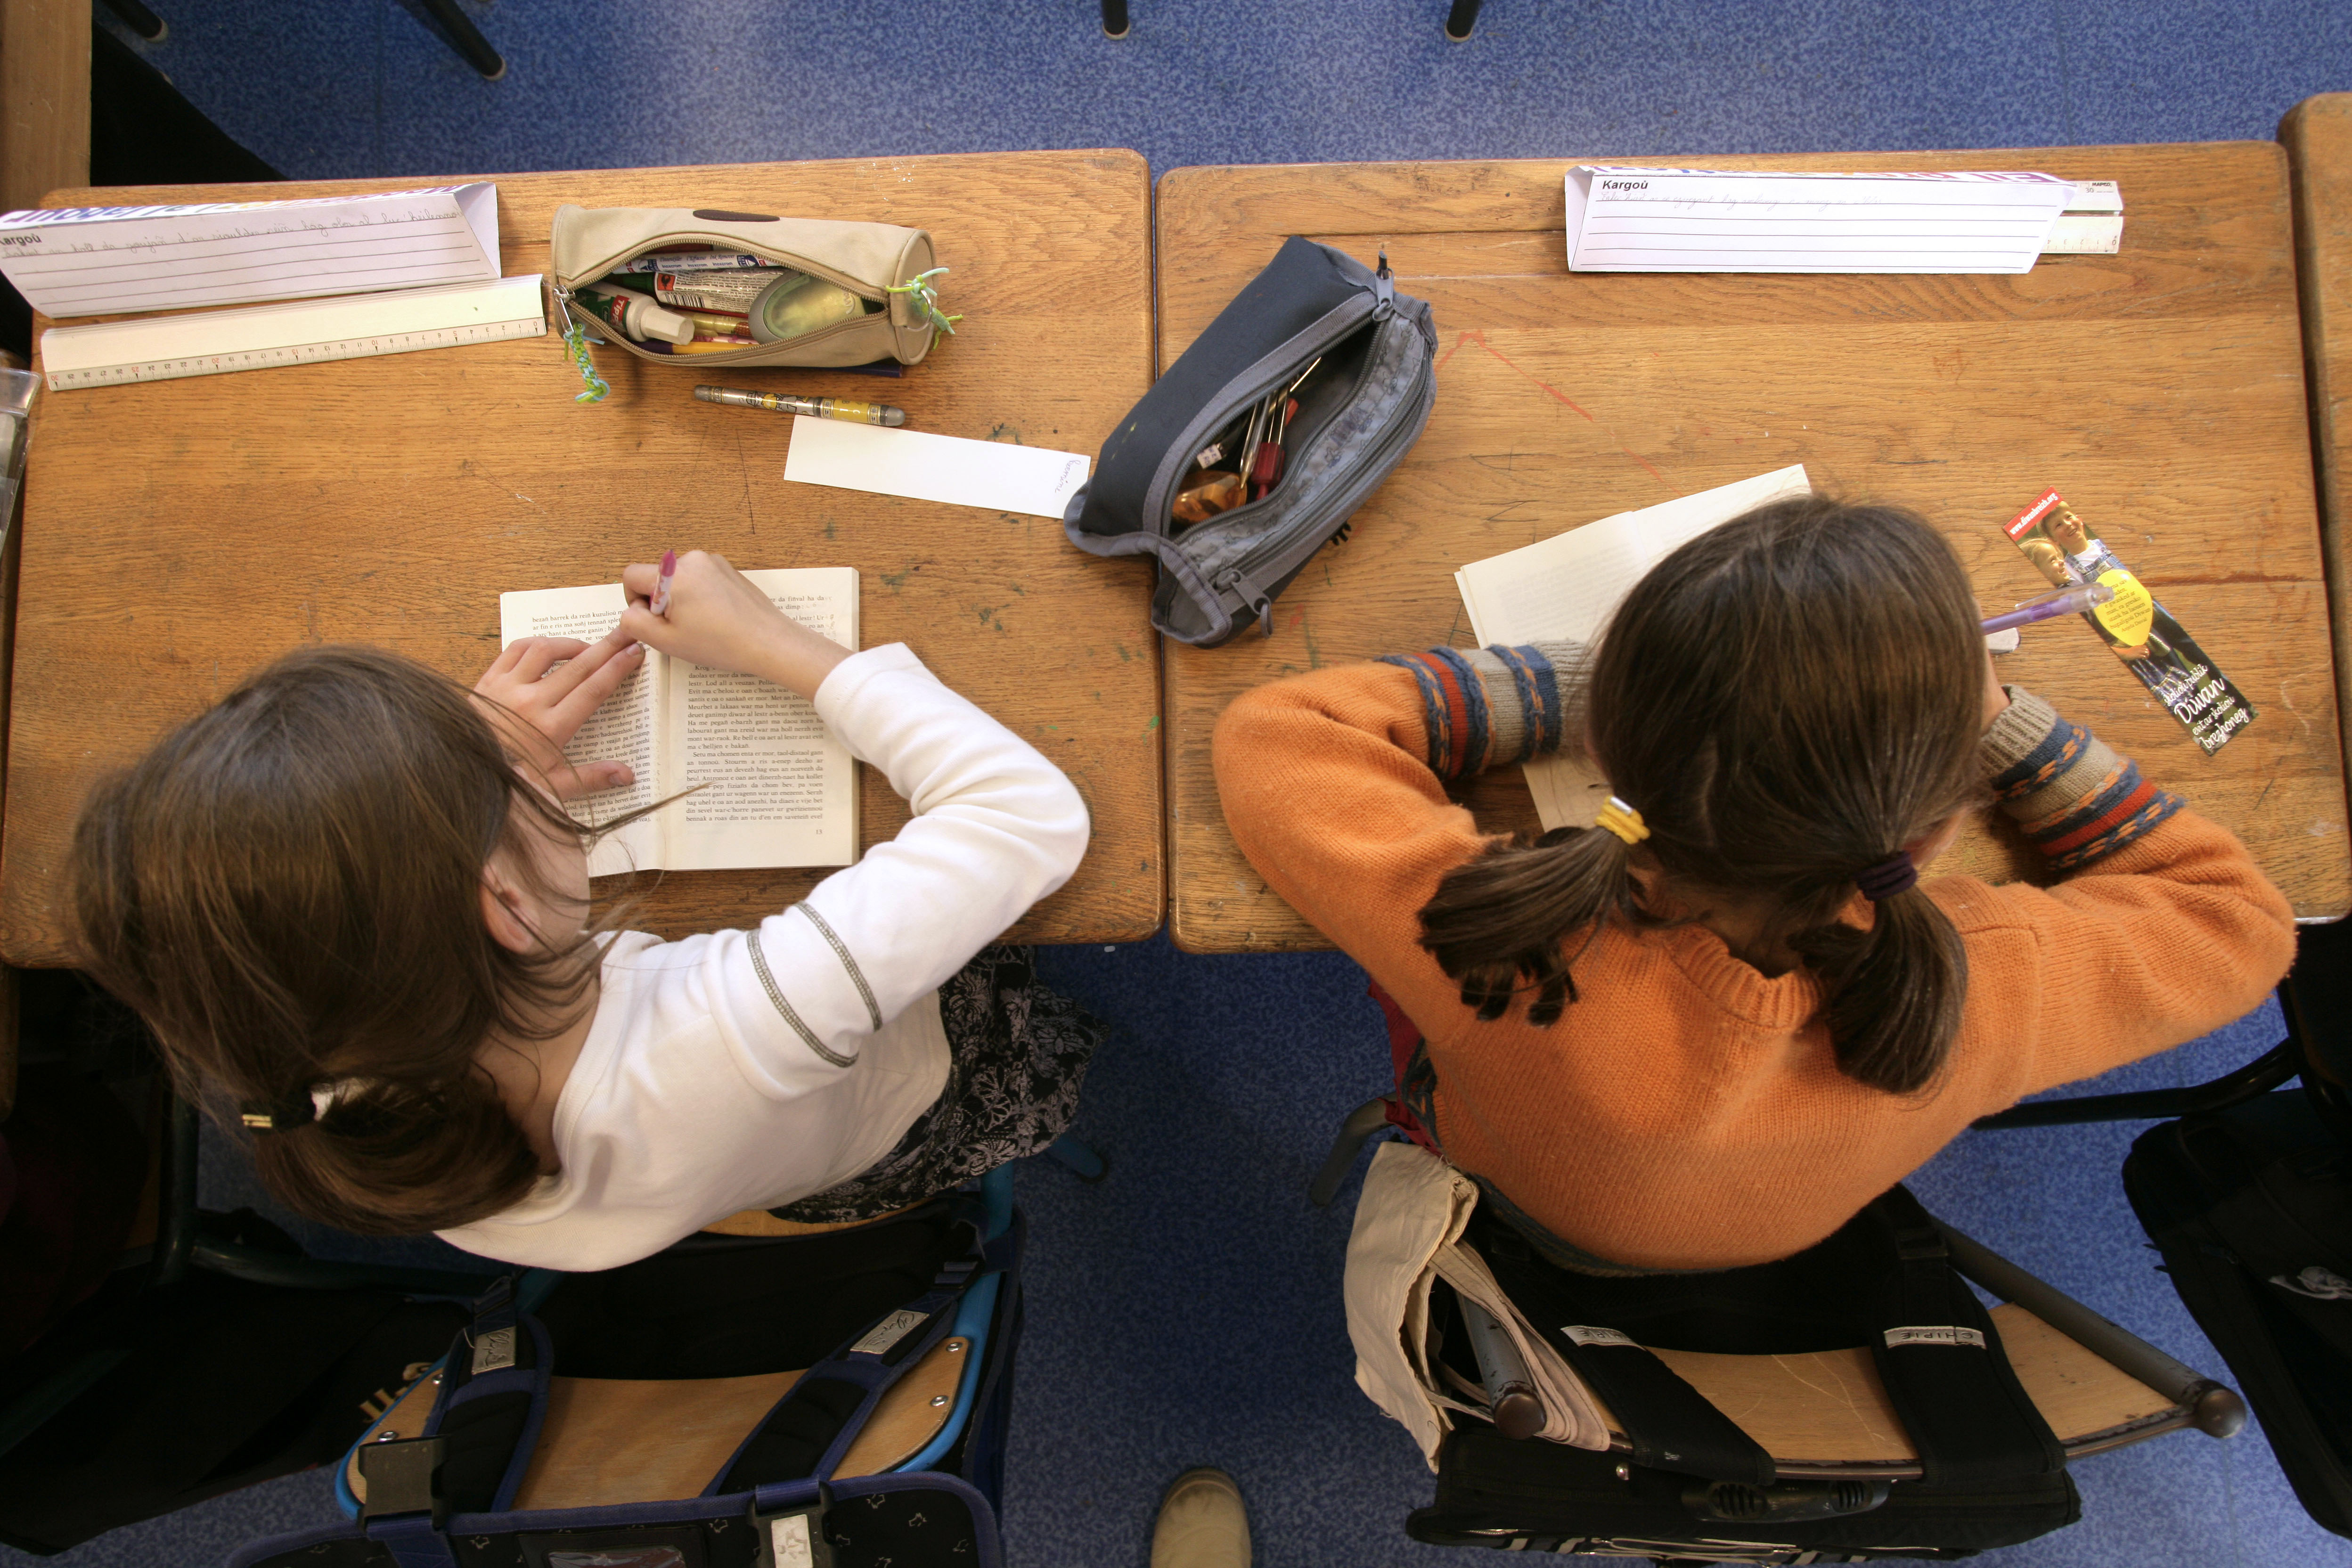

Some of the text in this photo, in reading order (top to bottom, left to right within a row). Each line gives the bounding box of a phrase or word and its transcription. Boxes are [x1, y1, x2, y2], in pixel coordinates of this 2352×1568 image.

[1602, 180, 1648, 191] Kargoù
[2009, 493, 2058, 535] www.diwanbreizh.org
[2186, 664, 2208, 690] publik
[2174, 678, 2225, 724] Diwan
[2199, 708, 2249, 748] brezhoneg
[2205, 715, 2213, 726] ar
